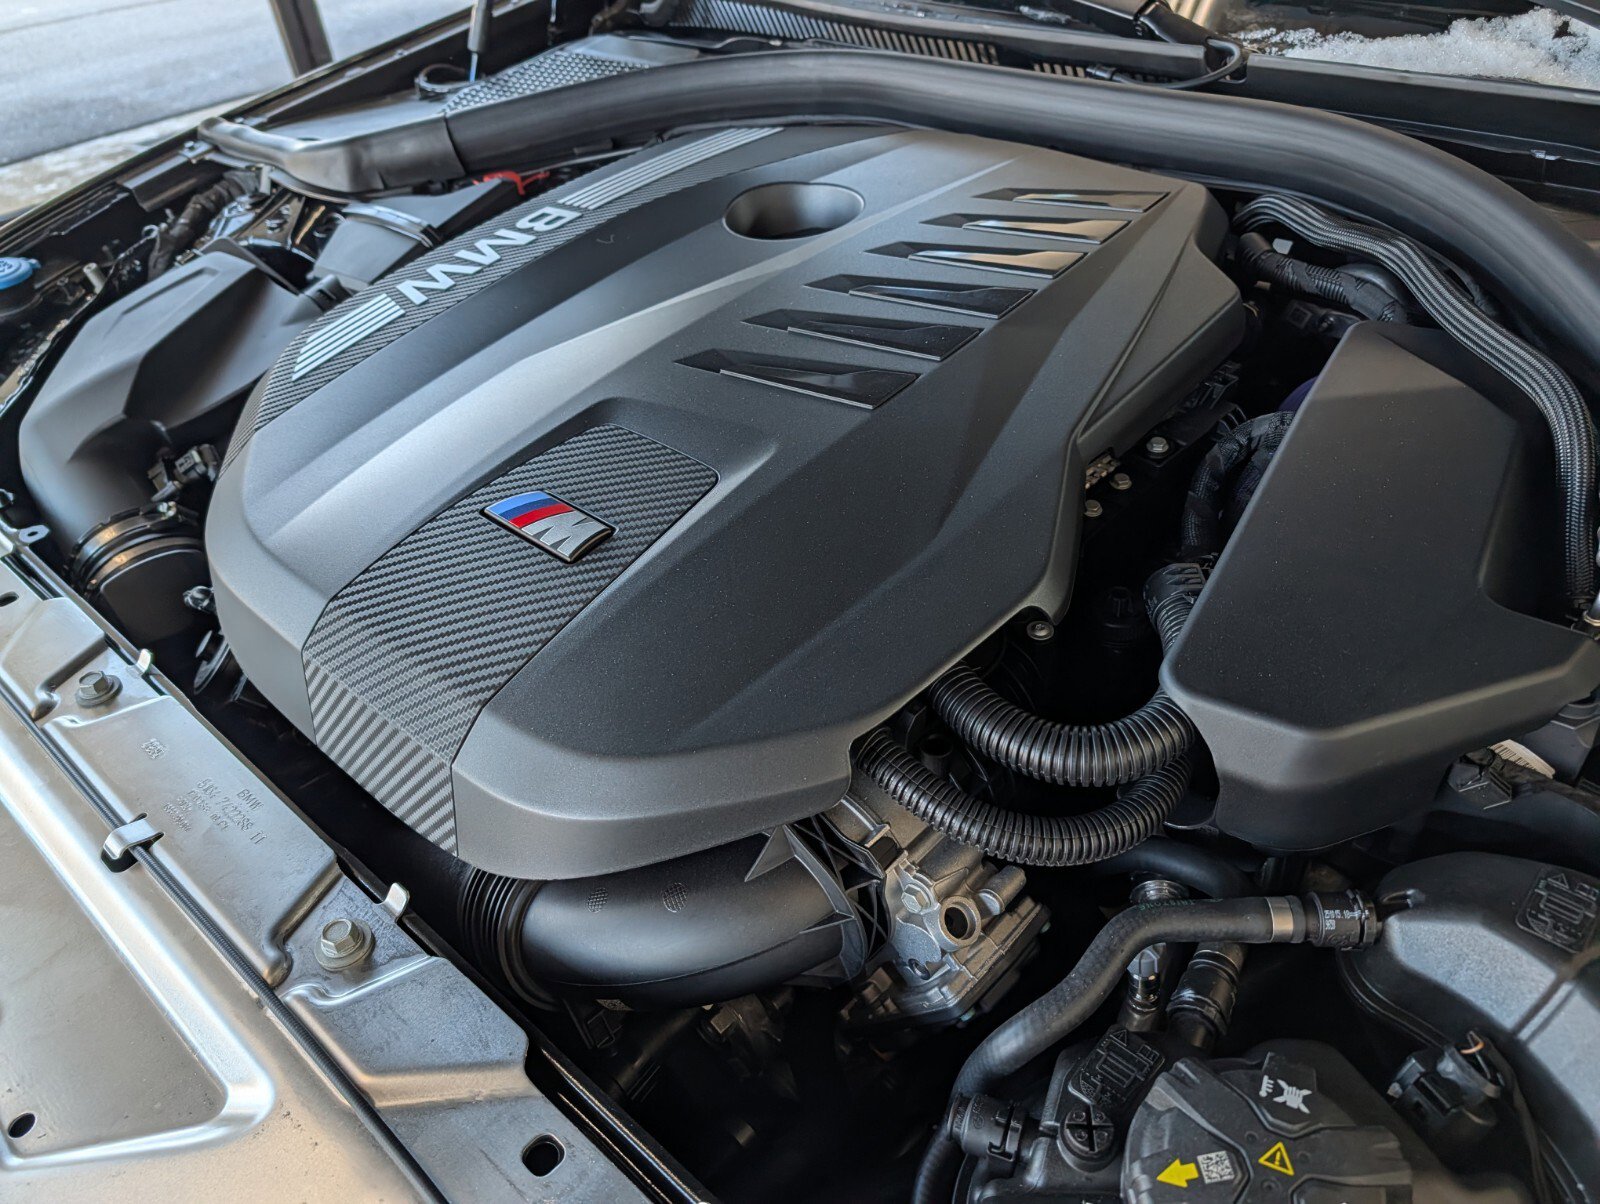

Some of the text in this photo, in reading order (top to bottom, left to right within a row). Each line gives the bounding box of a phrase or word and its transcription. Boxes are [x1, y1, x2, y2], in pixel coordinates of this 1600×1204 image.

[396, 206, 582, 306] BMW
[521, 510, 606, 557] M
[236, 788, 264, 812] BMW
